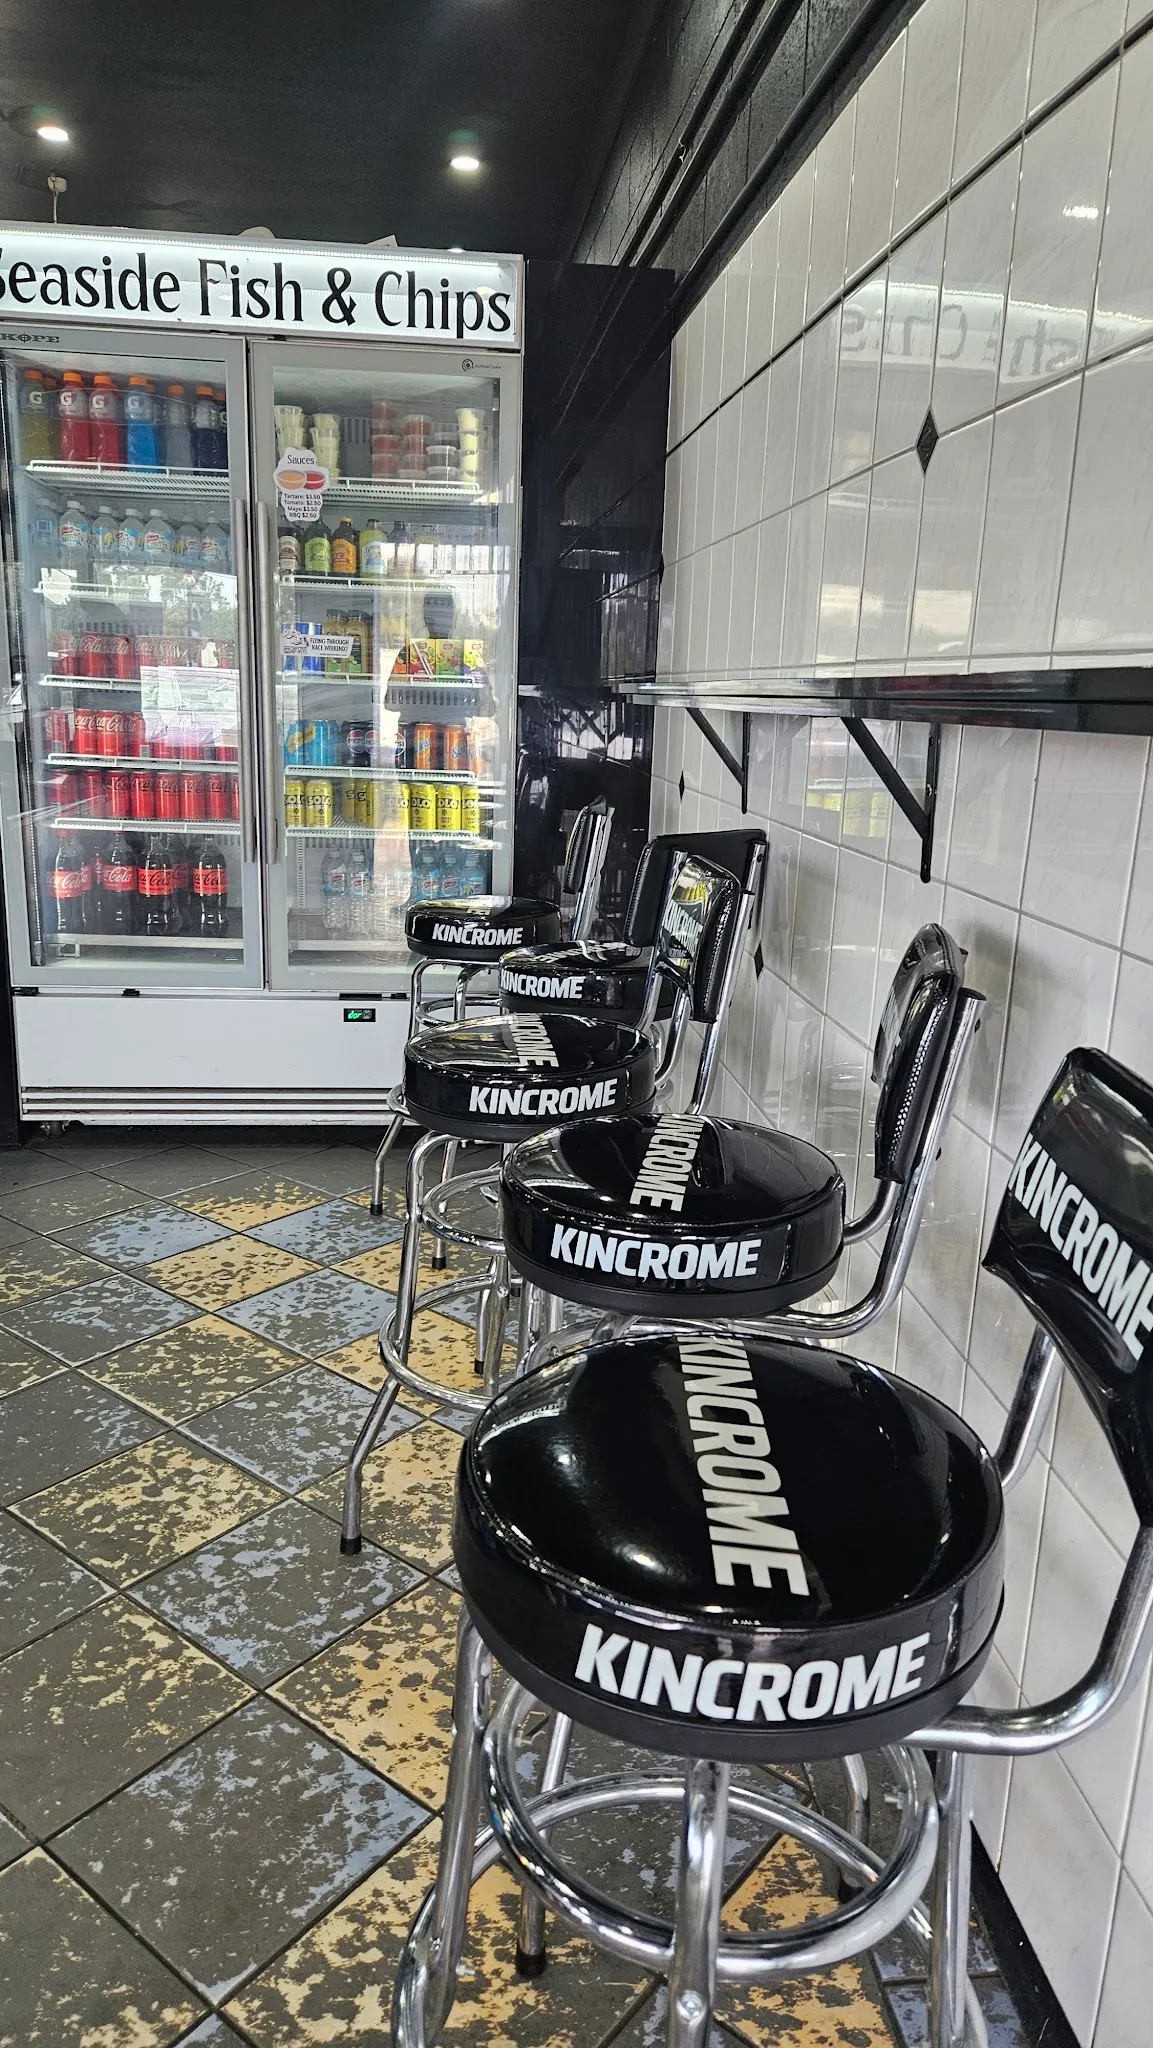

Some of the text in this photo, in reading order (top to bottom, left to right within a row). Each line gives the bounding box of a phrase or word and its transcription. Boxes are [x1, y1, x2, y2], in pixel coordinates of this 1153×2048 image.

[0, 247, 511, 339] easide Fish & Chips
[0, 332, 60, 344] KOPE
[60, 391, 72, 406] G
[92, 395, 105, 409] G
[127, 396, 140, 409] G
[287, 454, 315, 465] Sauces
[307, 794, 332, 807] SOLO
[432, 923, 524, 946] KINCROME
[500, 968, 587, 999] KINCROME
[509, 1012, 559, 1068] INCROME
[469, 1078, 619, 1116] KINCROME
[550, 1223, 762, 1282] KINCROME
[1008, 1131, 1153, 1362] KINCROME
[677, 1335, 810, 1597] KINCROME
[574, 1622, 932, 1723] KINCROME
